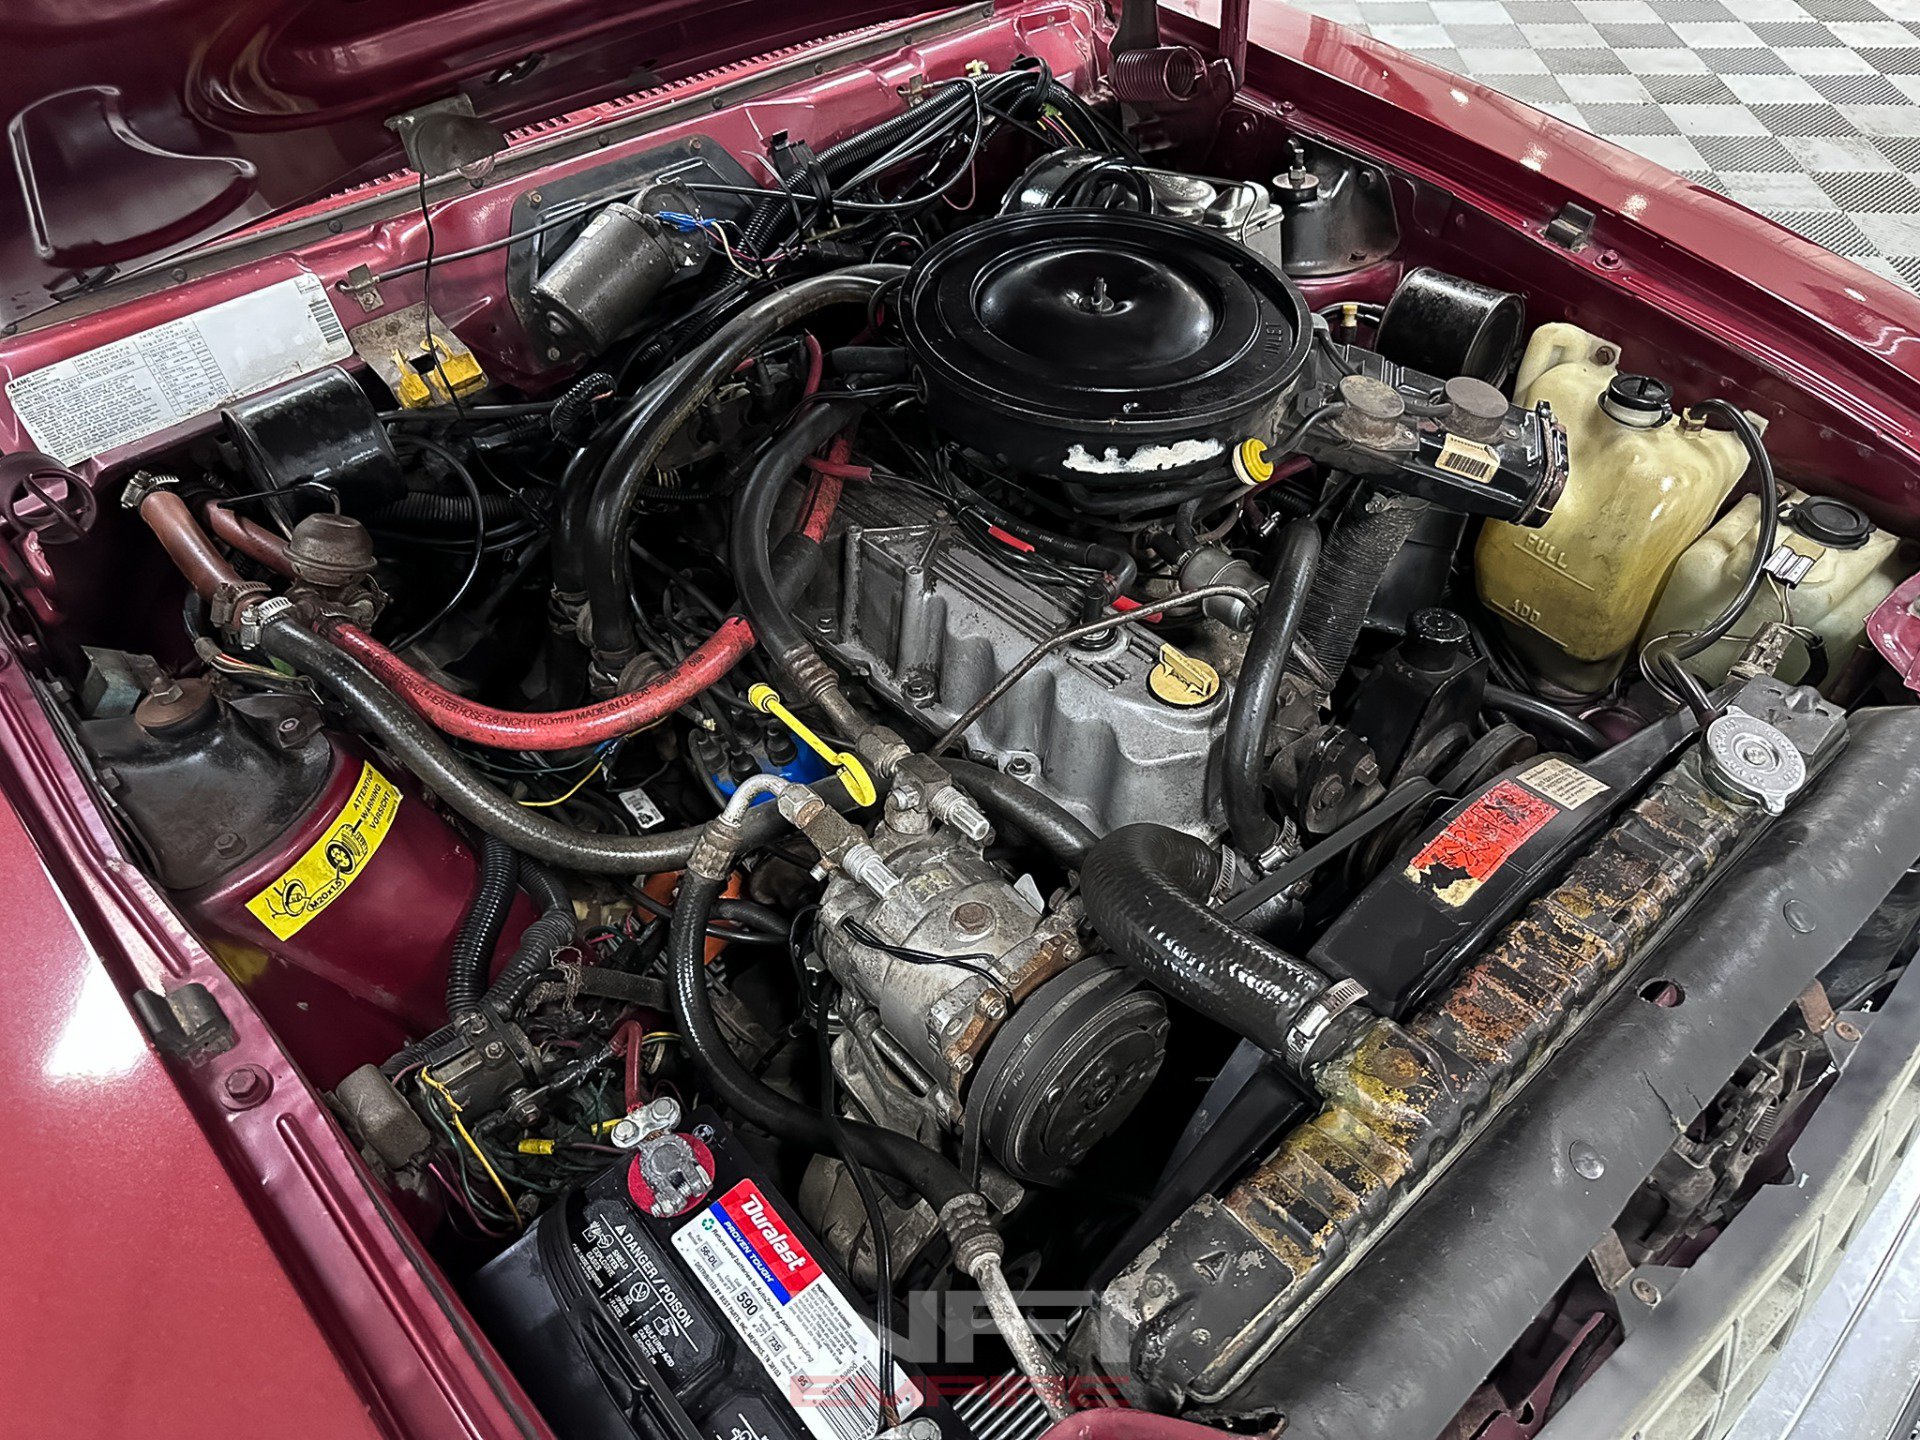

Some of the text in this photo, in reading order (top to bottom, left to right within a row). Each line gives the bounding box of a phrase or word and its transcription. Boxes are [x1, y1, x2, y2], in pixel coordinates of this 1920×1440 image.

[1264, 321, 1282, 355] INLET
[15, 376, 31, 386] AMC
[1525, 533, 1567, 568] FULL
[1512, 598, 1542, 622] ADD
[428, 690, 462, 715] HEATER
[459, 706, 485, 722] HOSE
[576, 705, 608, 720] MADE
[353, 770, 374, 811] ATTENTION
[361, 784, 382, 821] WARNING
[369, 790, 391, 830] VORSICHT
[738, 1192, 807, 1274] Duralast
[584, 1250, 602, 1271] GASES
[590, 1246, 616, 1277] EXPLOSIVE
[604, 1253, 620, 1270] EYES
[610, 1248, 629, 1270] SHIELD
[699, 1244, 720, 1268] 56-DL
[722, 1219, 774, 1284] PROVEN TOUGH
[620, 1232, 659, 1279] DANGER
[657, 1283, 695, 1328] POISON
[710, 1227, 816, 1363] Return used batteries to AutoZone for proper recycling
[622, 1294, 633, 1305] NO
[692, 1260, 718, 1290] DISTRIBUTED
[712, 1287, 722, 1297] BY
[717, 1293, 731, 1308] BEST
[725, 1305, 742, 1324] PARTS,
[762, 1354, 772, 1364] TN
[734, 1289, 760, 1318] 590
[641, 1323, 675, 1368] SULFURIC ACID
[643, 1338, 658, 1355] CAUSE
[766, 1334, 783, 1353] 735
[795, 1373, 808, 1387] 95
